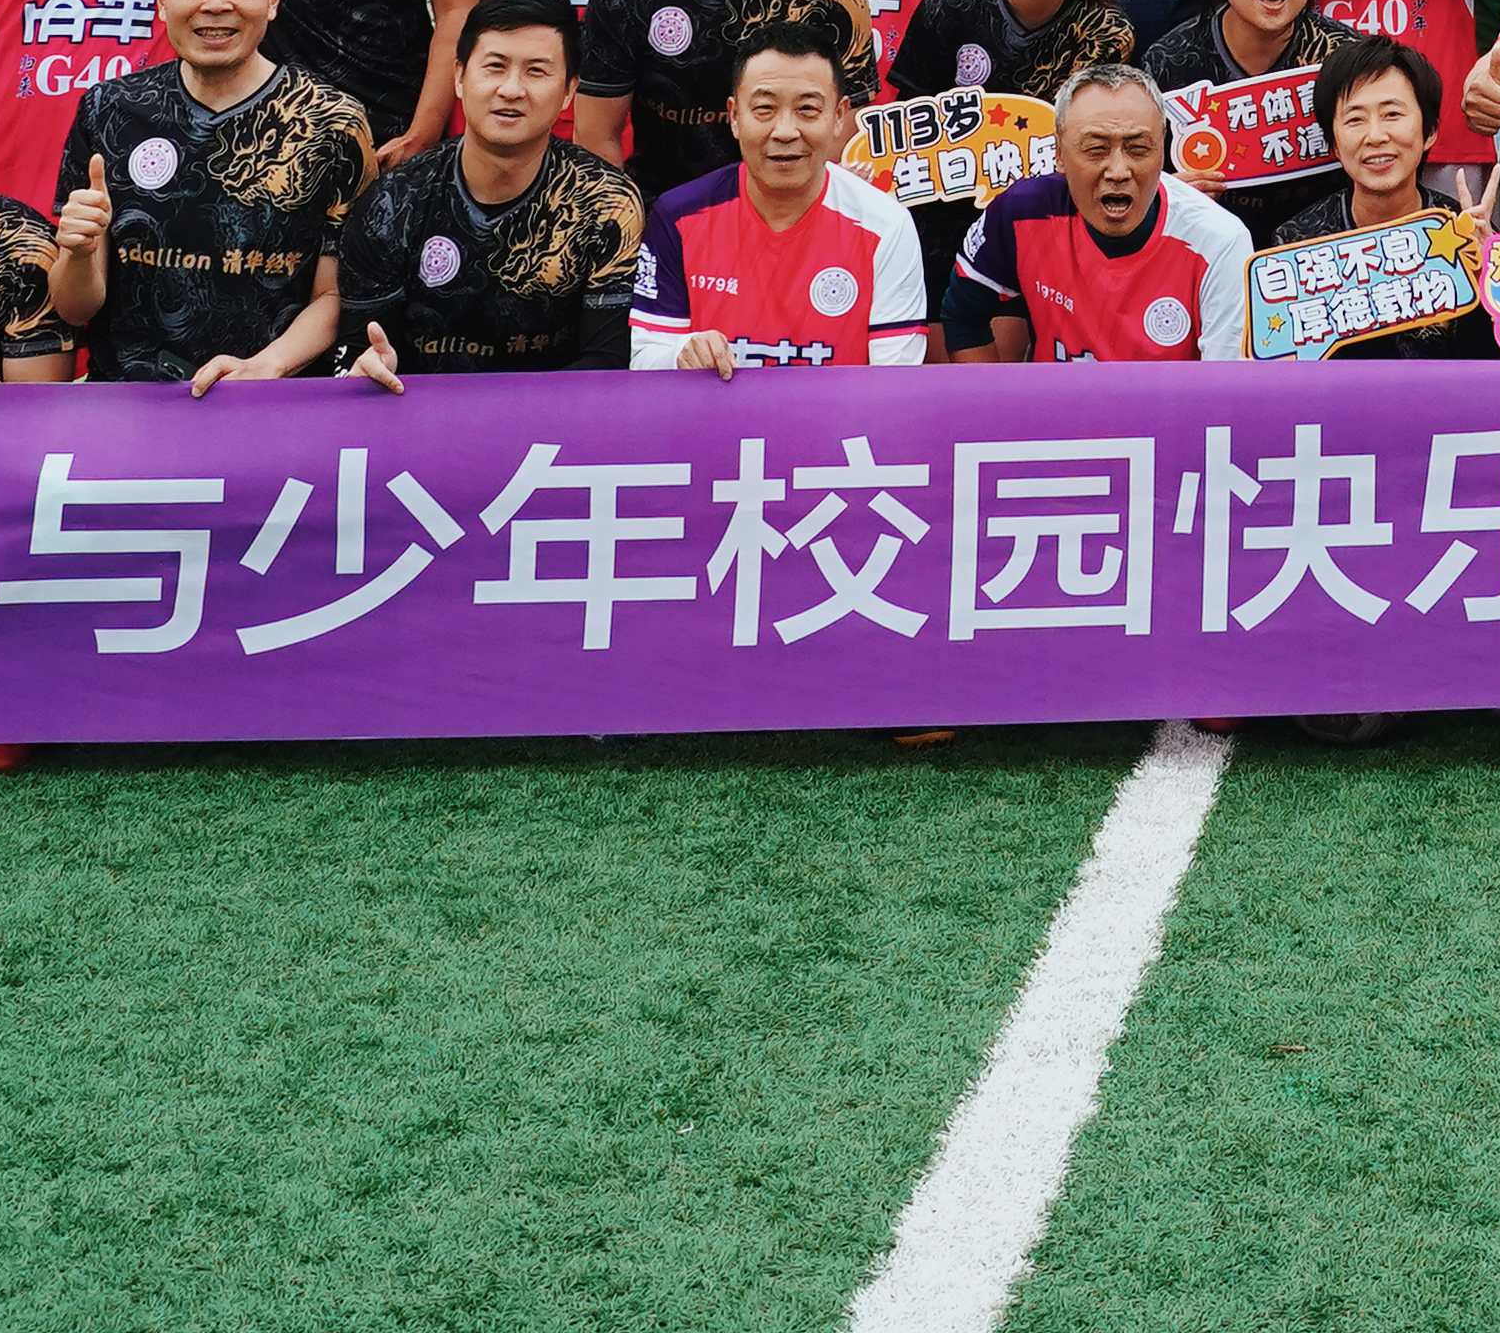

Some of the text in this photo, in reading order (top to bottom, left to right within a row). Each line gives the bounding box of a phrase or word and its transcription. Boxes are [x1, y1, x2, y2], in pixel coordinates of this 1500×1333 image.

[36, 54, 132, 97] G40
[862, 90, 984, 158] 113岁
[1261, 122, 1330, 166] 不清
[892, 134, 1058, 202] 生日快乐
[118, 244, 211, 271] edallion
[690, 274, 739, 296] 1979级
[1255, 229, 1425, 303] 自强不息
[1287, 270, 1456, 346] 厚德载物
